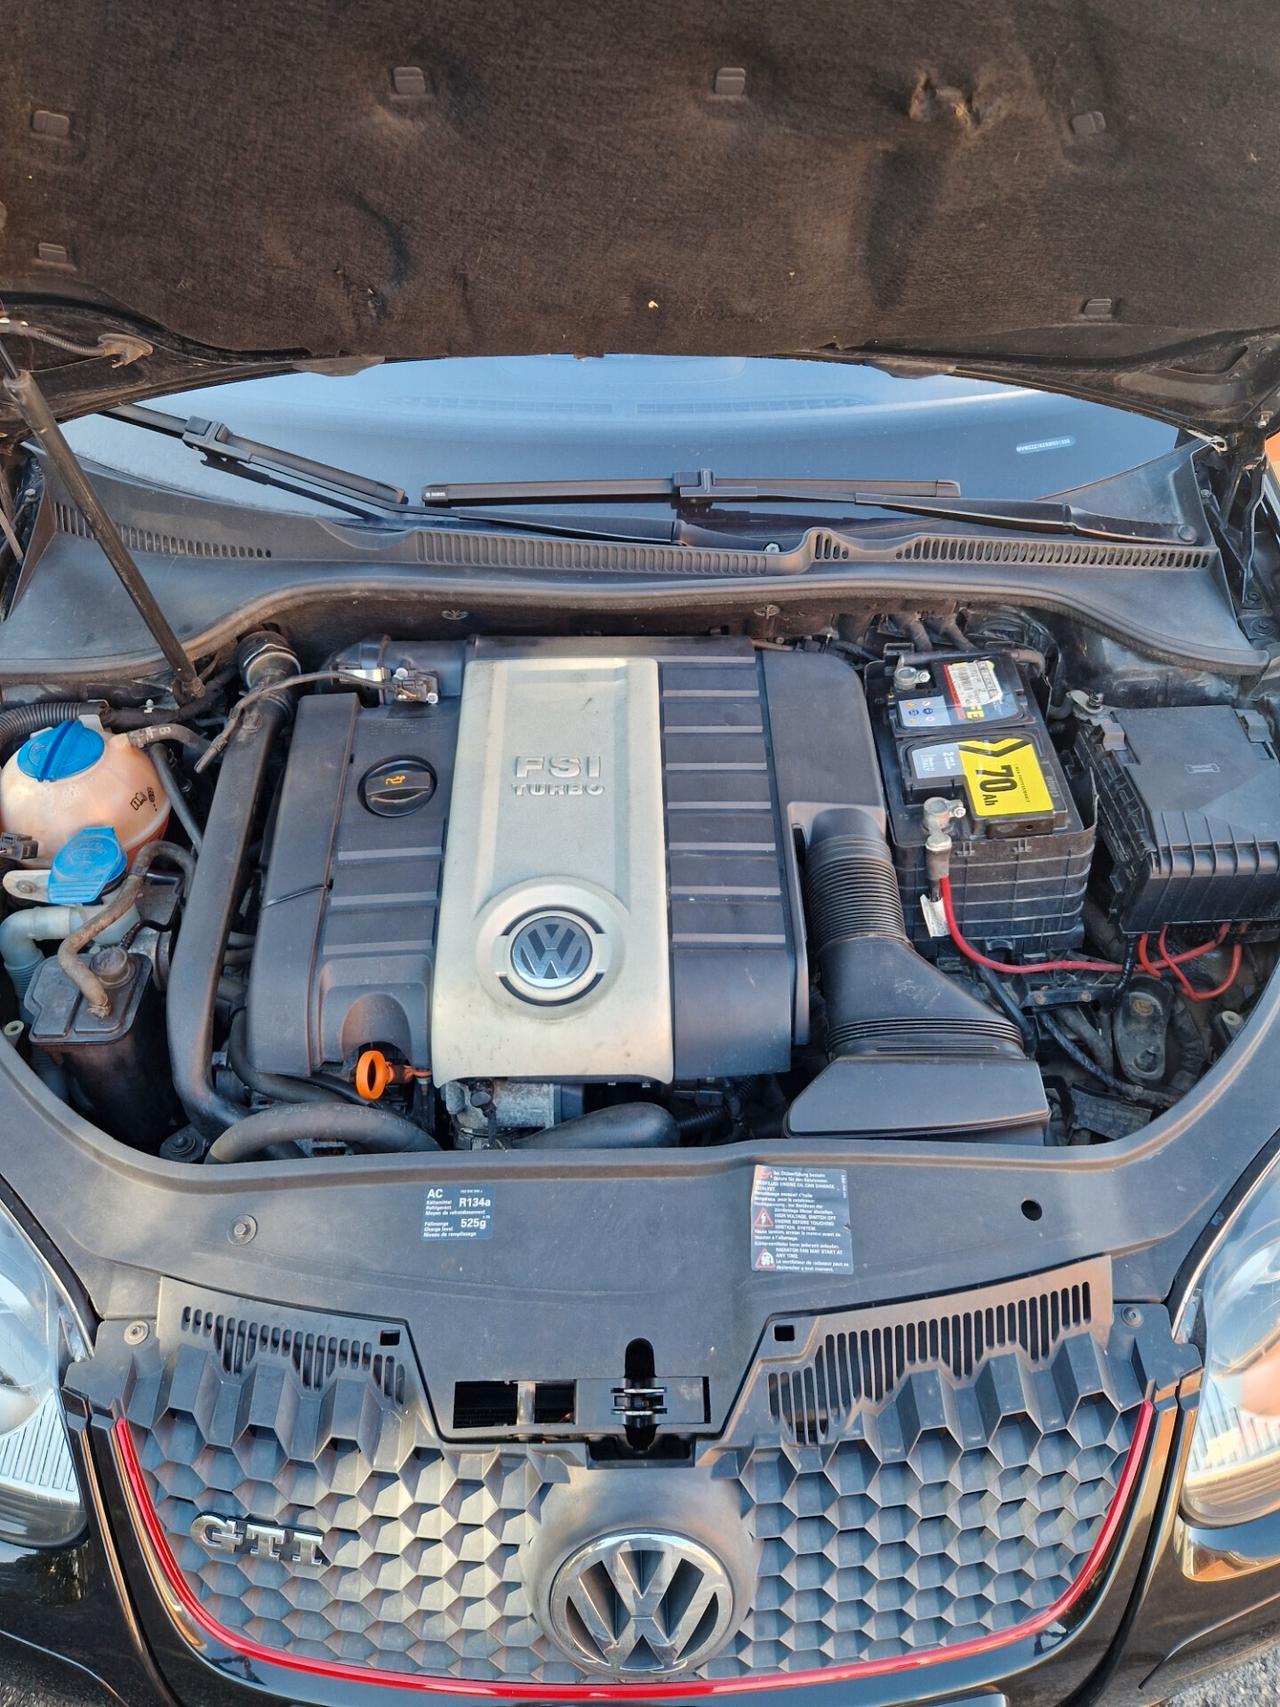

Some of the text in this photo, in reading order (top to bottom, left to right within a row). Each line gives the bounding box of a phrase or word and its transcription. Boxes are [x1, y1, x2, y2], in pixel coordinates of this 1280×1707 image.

[515, 755, 602, 778] FSI
[511, 783, 605, 796] TURBO
[976, 765, 1017, 806] 70 Ah
[427, 1189, 443, 1198] AC
[459, 1198, 491, 1207] R134a
[461, 1218, 486, 1229] 525g
[190, 1511, 329, 1566] GTI
[549, 1529, 735, 1679] VW
